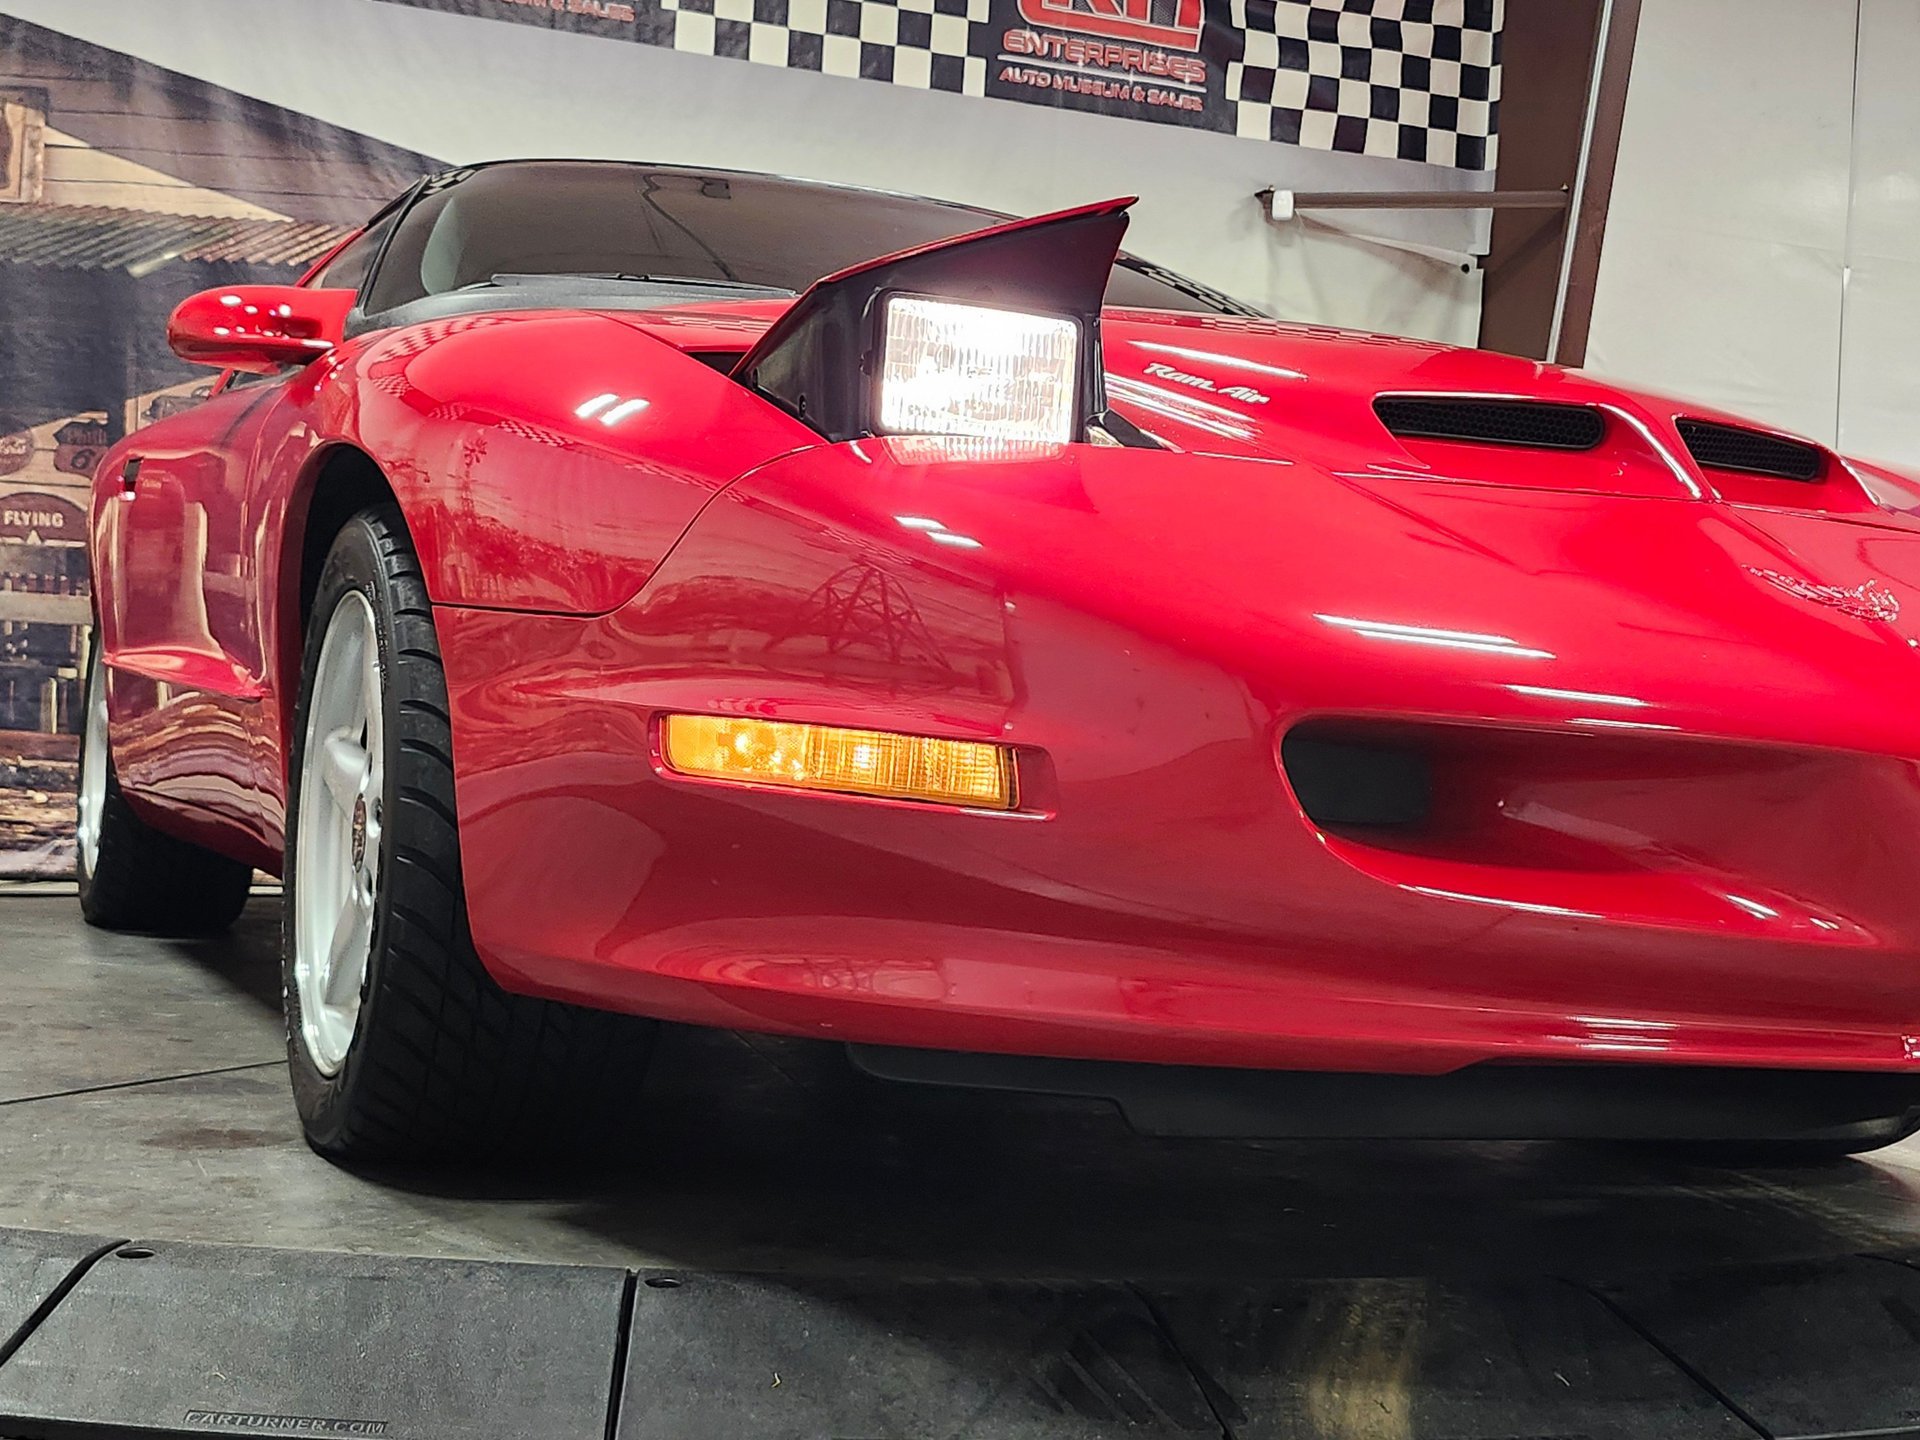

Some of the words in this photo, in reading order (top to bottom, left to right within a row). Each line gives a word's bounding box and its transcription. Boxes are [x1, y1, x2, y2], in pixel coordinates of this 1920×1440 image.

[1003, 28, 1206, 83] ENTERPRISES
[999, 67, 1051, 88] AUTO
[1053, 74, 1130, 100] MUSEUM
[1132, 86, 1145, 103] &
[1147, 88, 1203, 112] SALES
[1142, 362, 1217, 392] Ram
[1217, 385, 1271, 404] Air
[4, 510, 63, 527] FLYING
[185, 1412, 385, 1434] CARTURNER.COM
